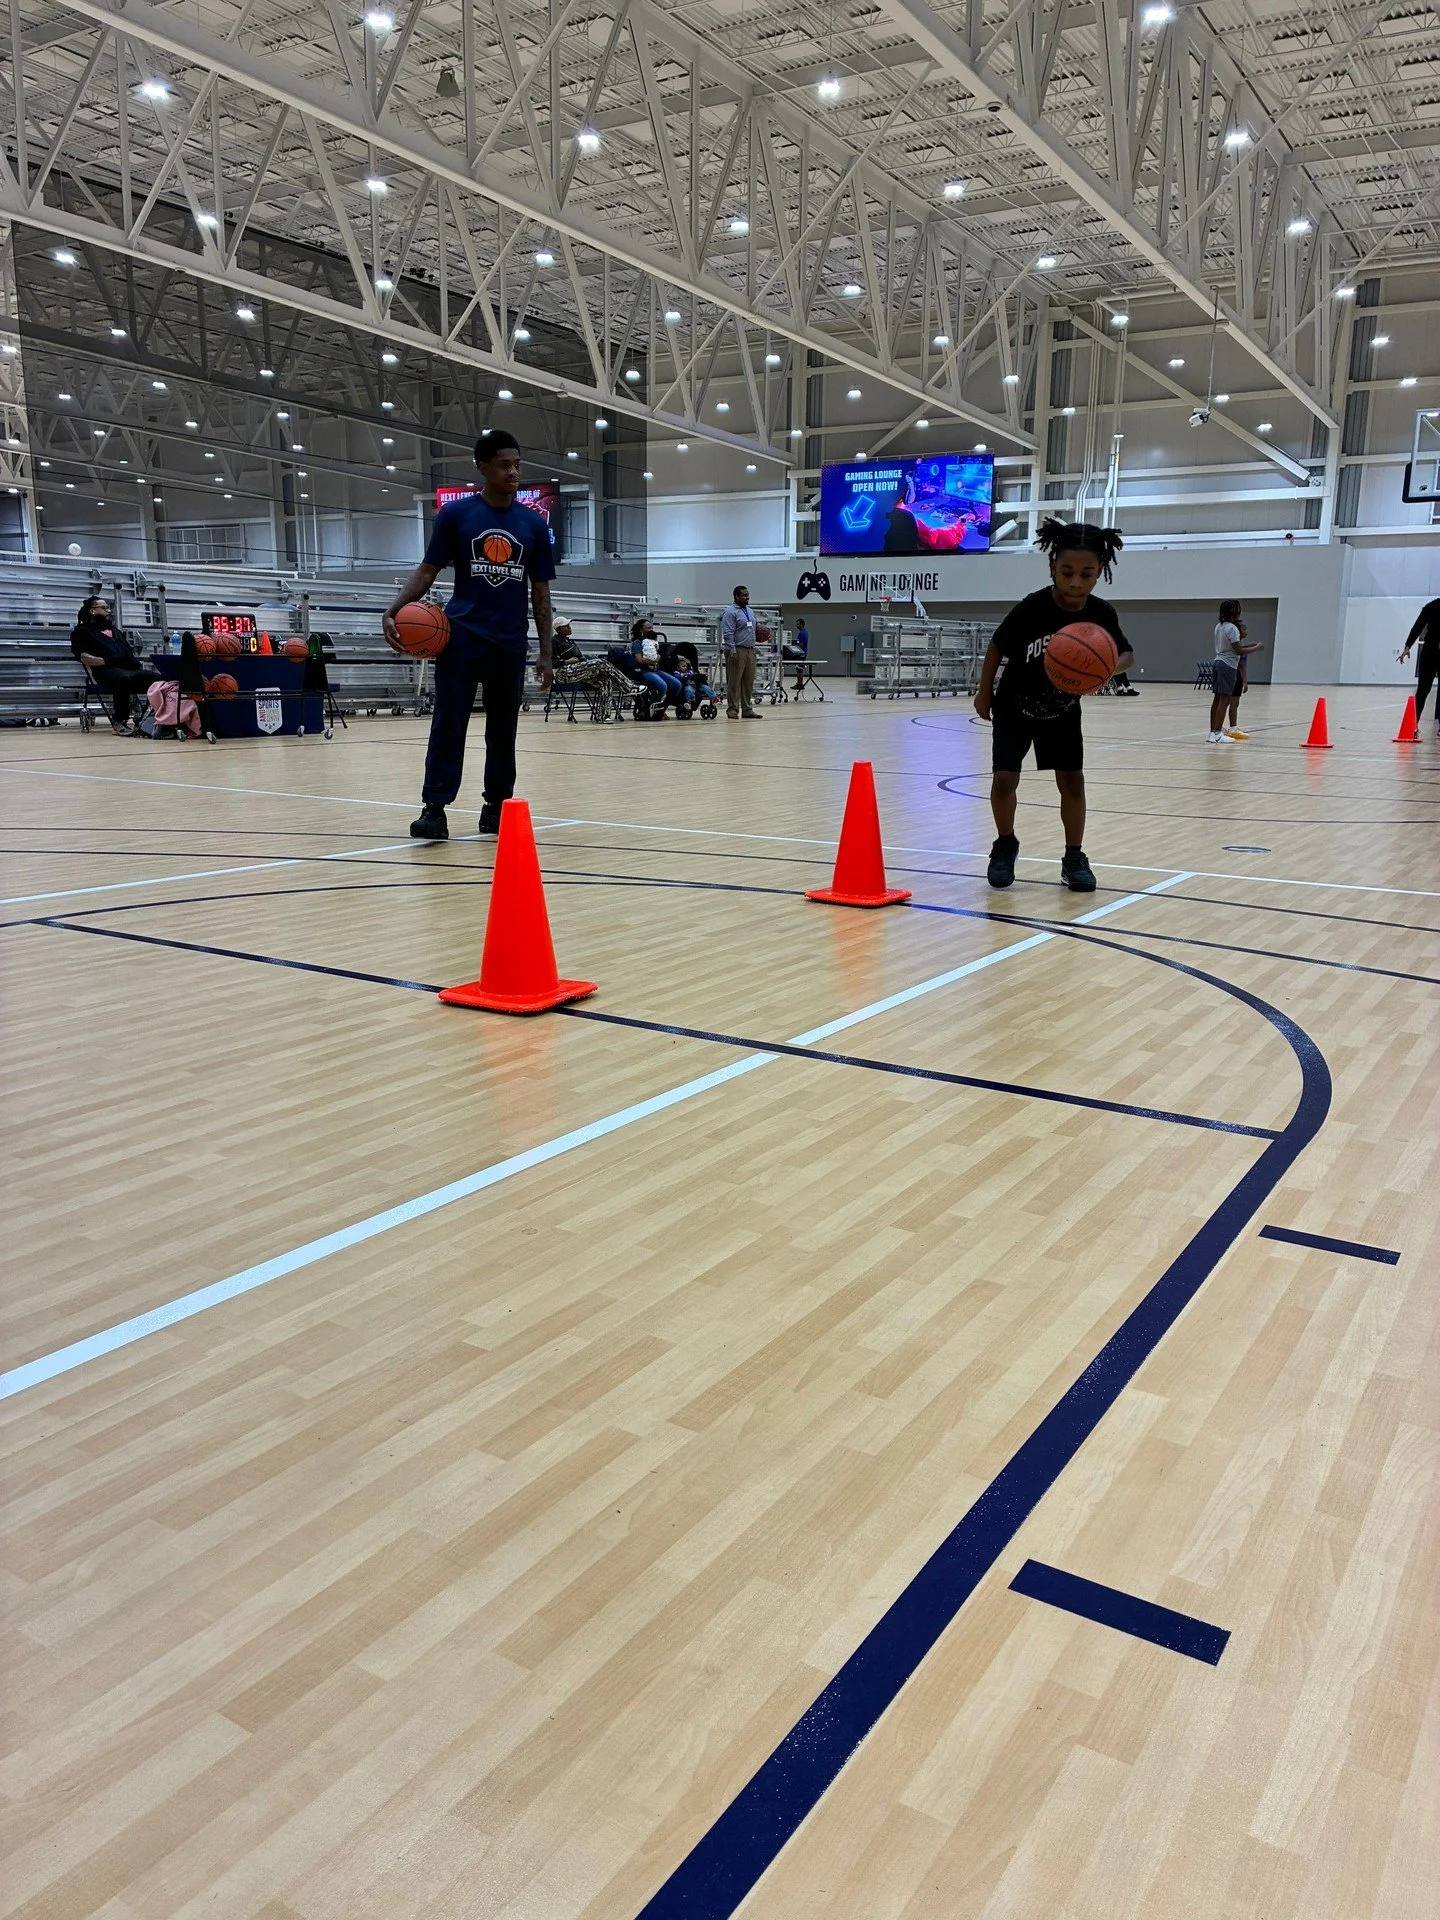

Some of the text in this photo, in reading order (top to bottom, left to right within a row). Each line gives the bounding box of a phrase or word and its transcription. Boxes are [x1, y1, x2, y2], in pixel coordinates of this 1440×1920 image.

[845, 469, 903, 481] GAMING LOUNGE
[852, 481, 898, 492] OPEN NOW!
[440, 492, 456, 502] NEXT
[488, 565, 510, 575] LEVEL
[839, 572, 939, 592] GAMING LOUNGE
[213, 616, 251, 632] 35:37
[1025, 633, 1056, 663] POS
[258, 700, 280, 709] SPORTS
